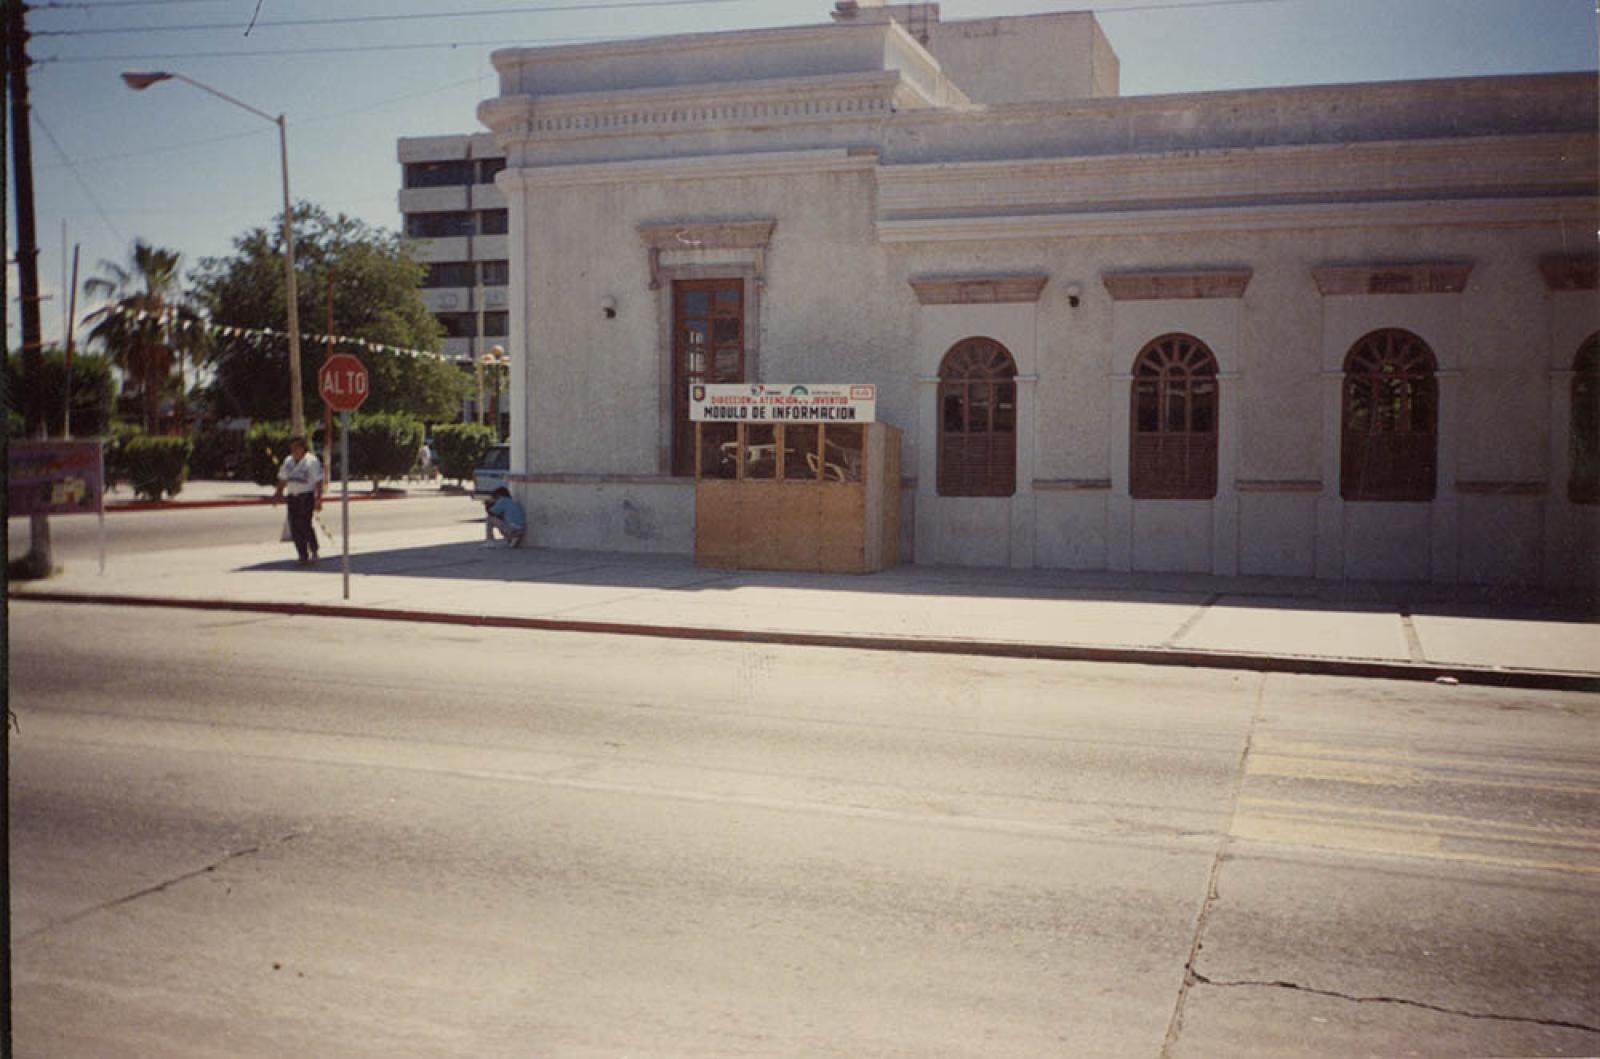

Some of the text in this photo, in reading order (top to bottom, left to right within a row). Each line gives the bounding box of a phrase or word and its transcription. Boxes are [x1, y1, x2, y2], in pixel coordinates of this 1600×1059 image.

[322, 370, 366, 395] ALTO
[703, 406, 856, 419] MODULO DE INFORMACION
